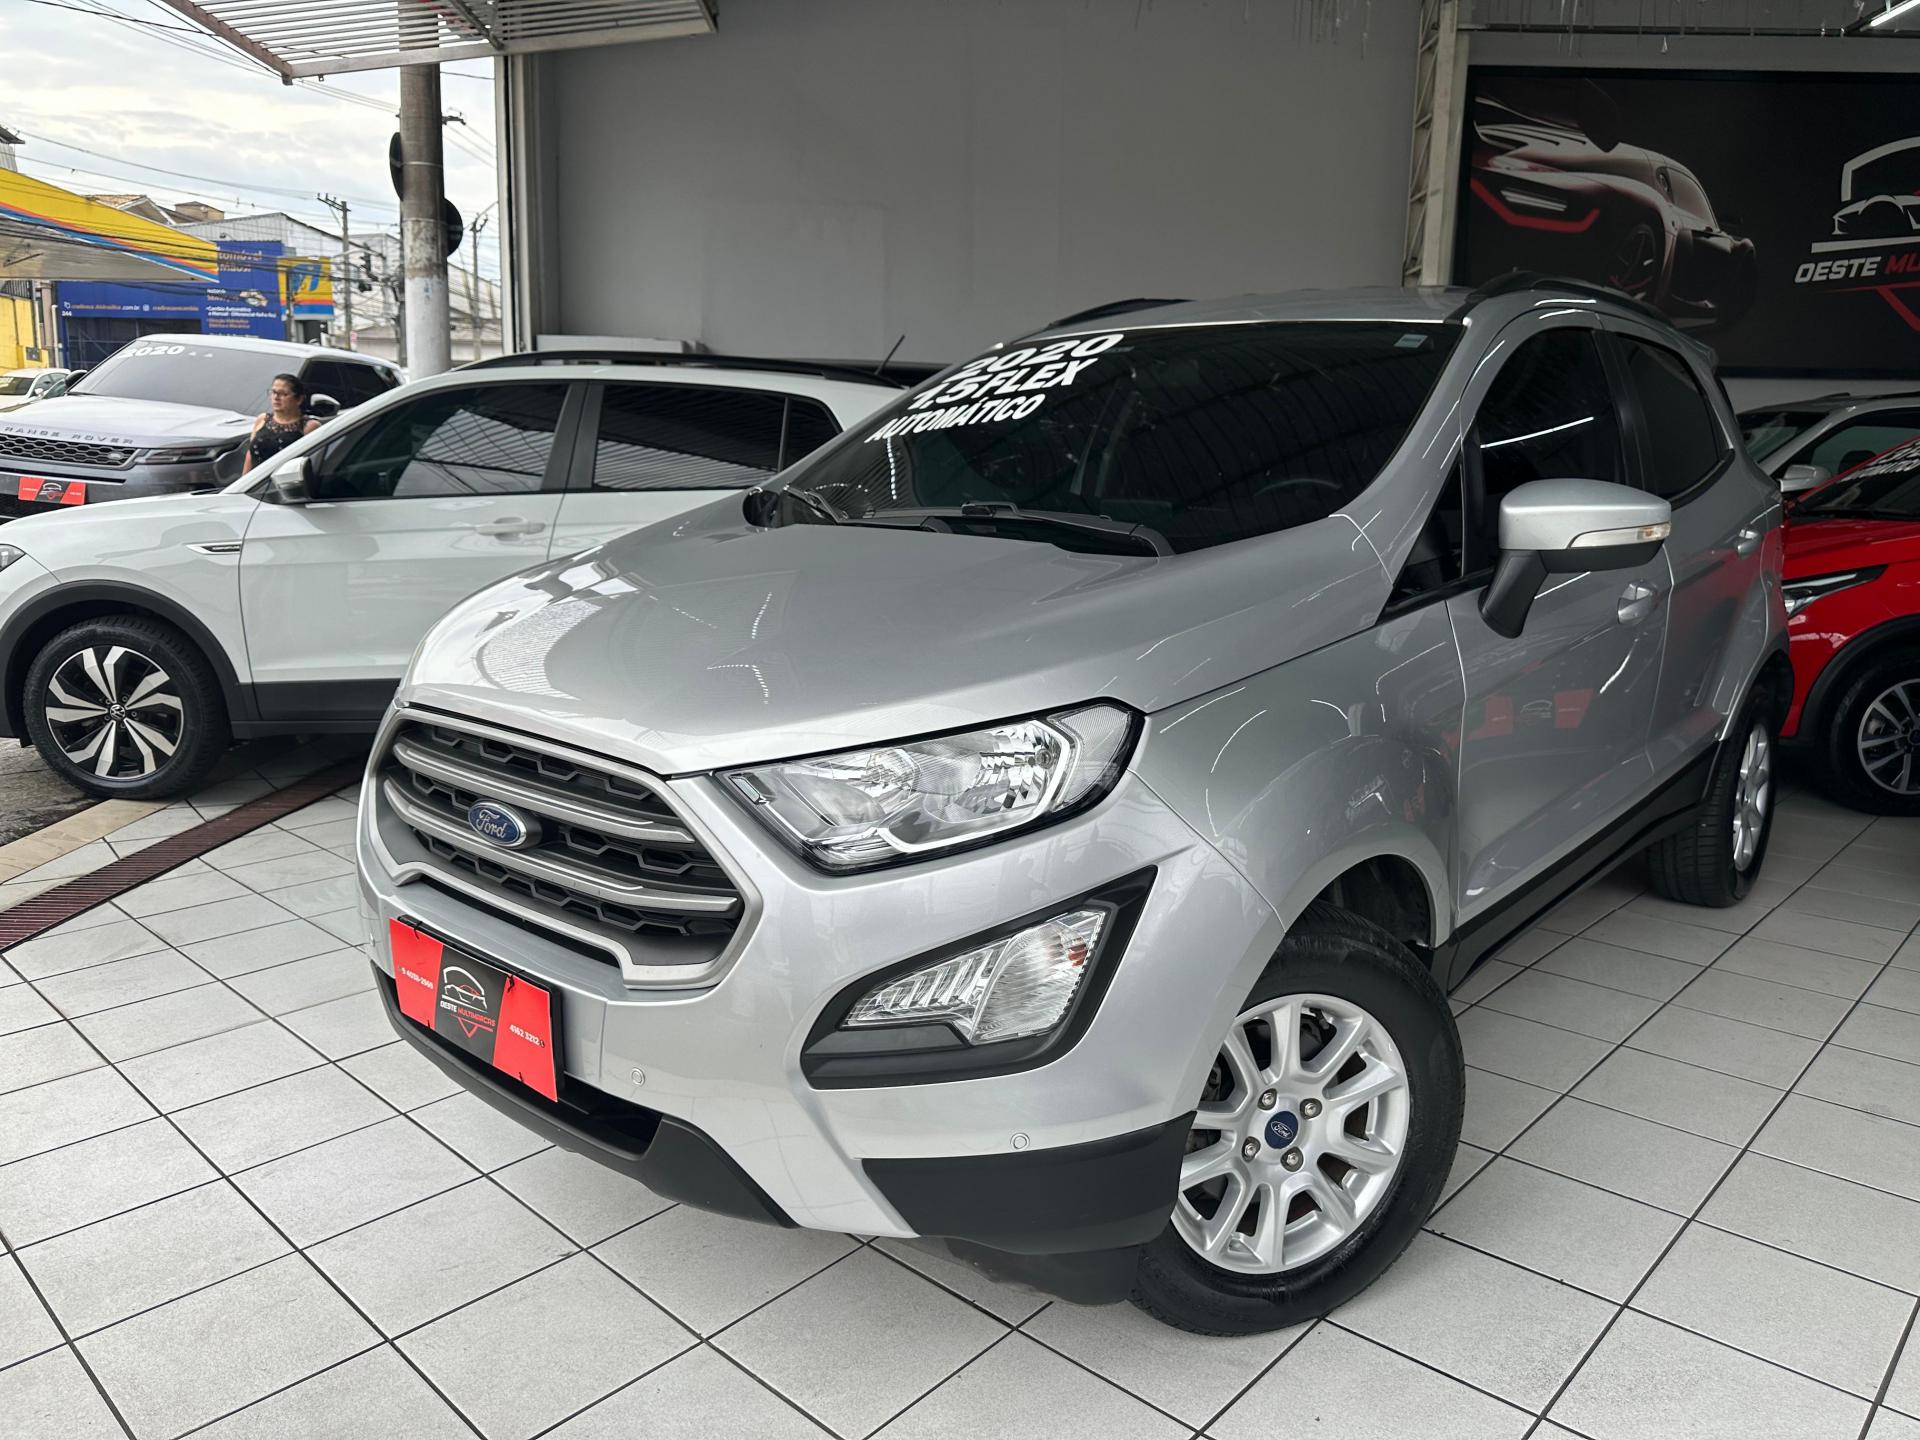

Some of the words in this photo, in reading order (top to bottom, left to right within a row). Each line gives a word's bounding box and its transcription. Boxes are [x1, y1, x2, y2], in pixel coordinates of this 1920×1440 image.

[1794, 256, 1882, 283] OESTE
[117, 345, 185, 359] 2020
[943, 333, 1125, 384] 2020
[971, 357, 1099, 399] FLEX
[864, 394, 1046, 444] AUTOMÁTICO
[71, 433, 134, 445] ROVER
[475, 810, 508, 838] Ford
[439, 1000, 458, 1013] OESTE
[1273, 1124, 1291, 1138] Ford
